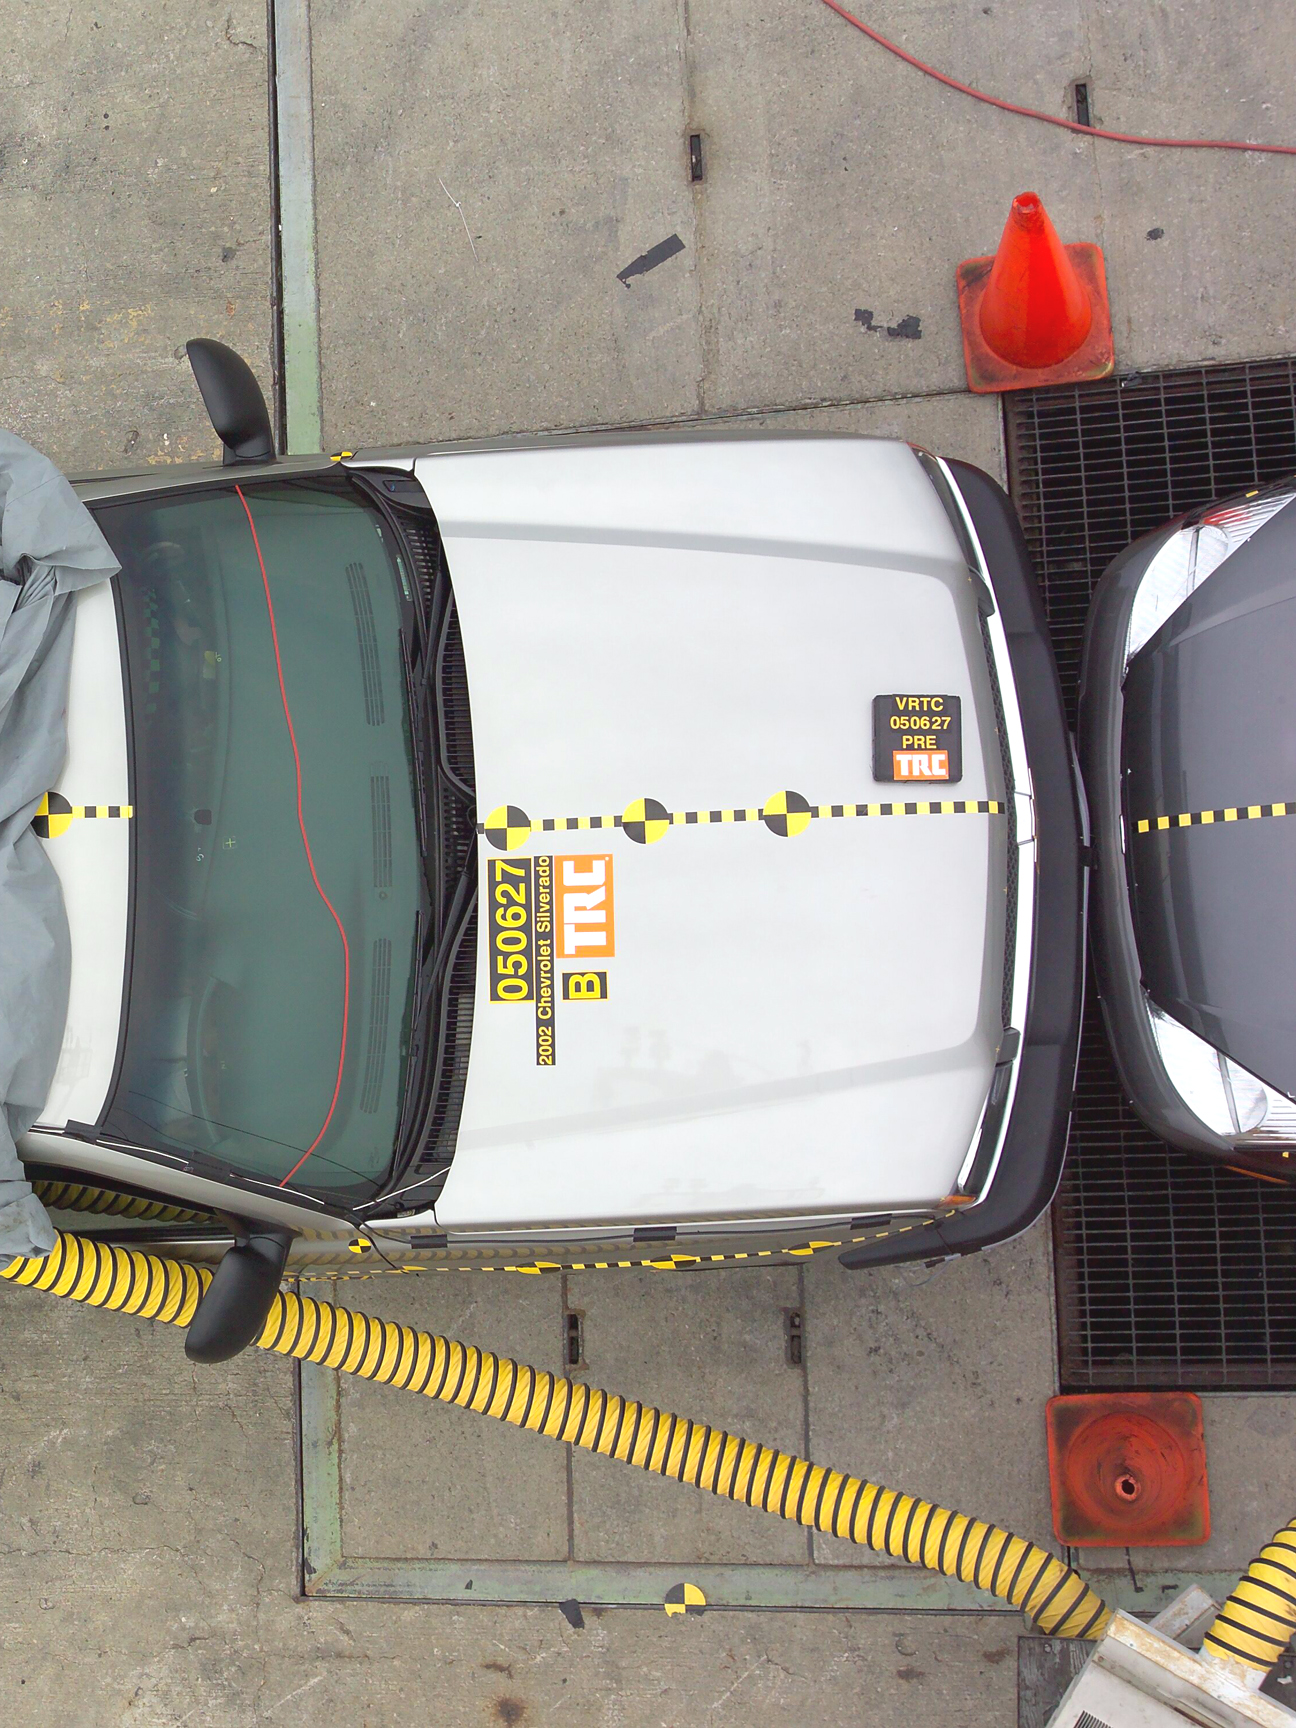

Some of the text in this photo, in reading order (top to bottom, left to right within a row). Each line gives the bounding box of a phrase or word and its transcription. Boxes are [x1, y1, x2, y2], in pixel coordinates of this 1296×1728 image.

[895, 697, 944, 711] VRTC
[890, 716, 951, 730] 050627
[902, 735, 937, 749] PRE
[896, 754, 946, 776] TRC
[562, 858, 608, 955] TRC
[495, 860, 529, 1000] 050627
[536, 855, 553, 1065] 2002 Chevrolet Silverado
[568, 972, 601, 999] B
